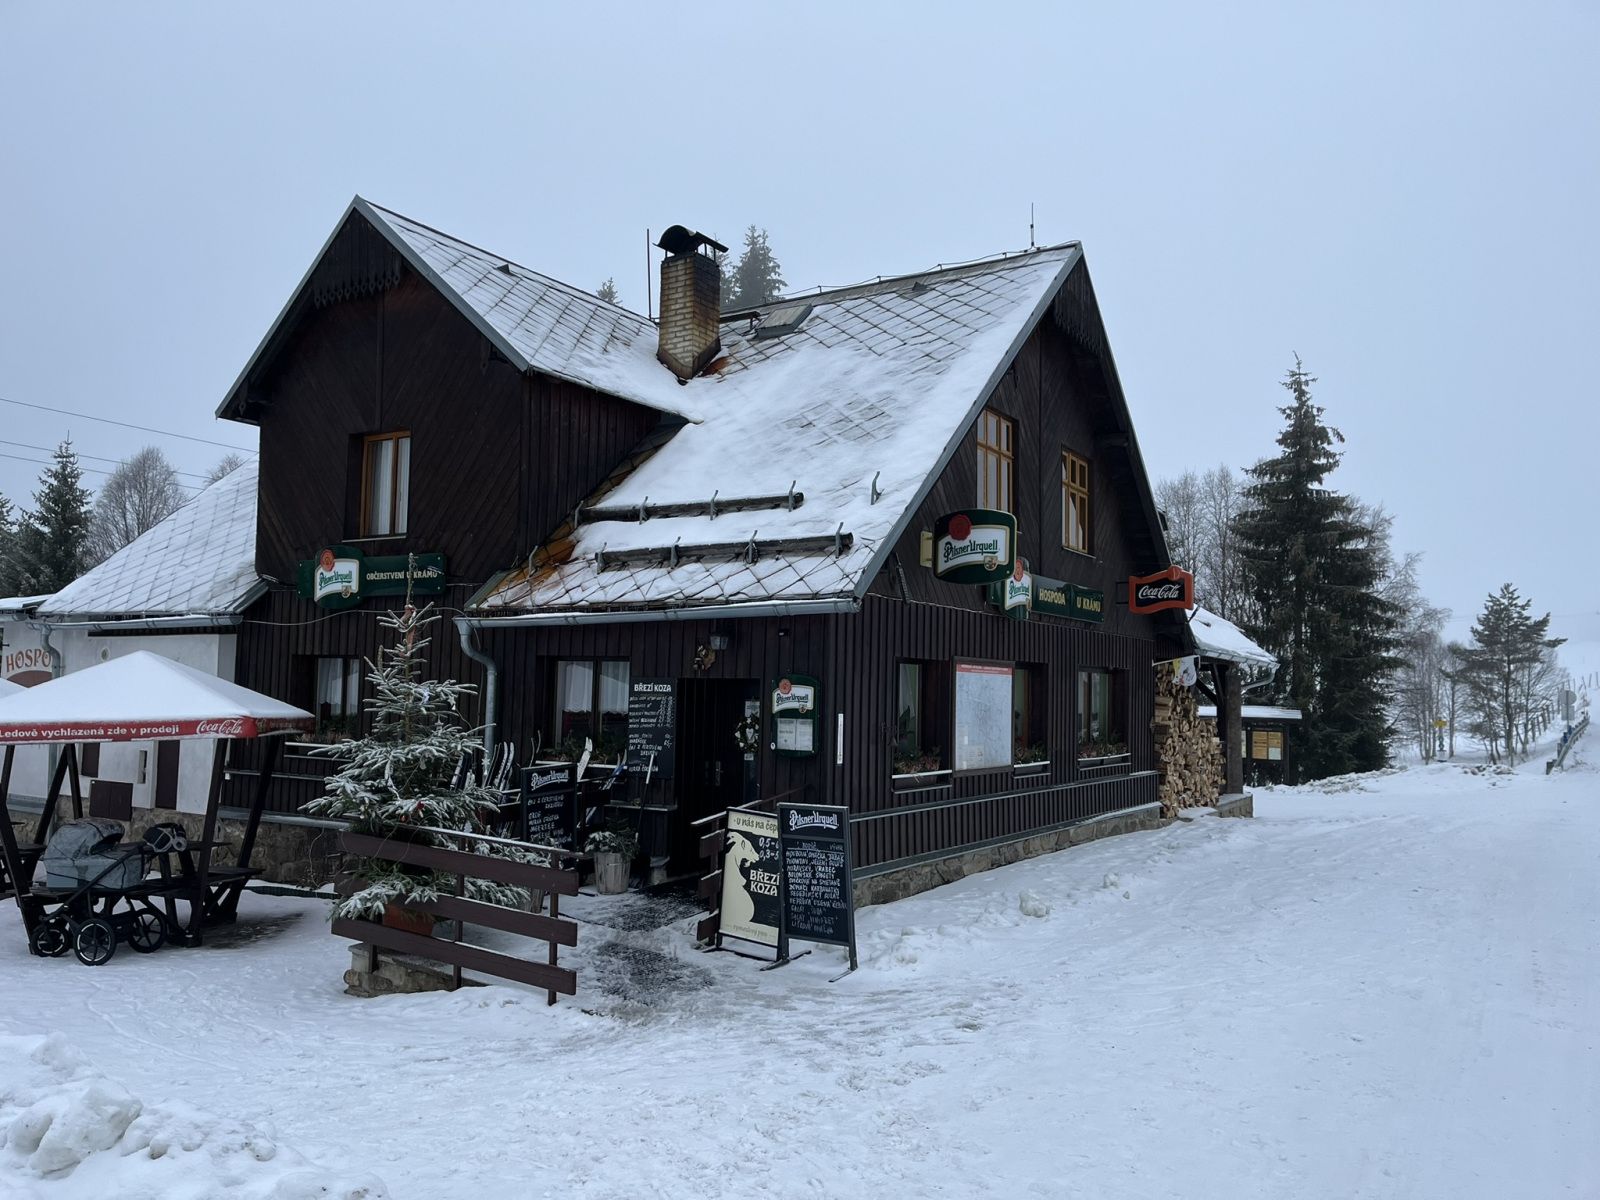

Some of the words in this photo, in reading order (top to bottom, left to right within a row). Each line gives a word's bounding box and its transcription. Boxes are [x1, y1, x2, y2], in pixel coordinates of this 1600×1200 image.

[943, 541, 970, 564] Pilsner
[969, 539, 998, 556] Urquell
[366, 570, 405, 581] OBČERSTVENÍ
[1039, 588, 1066, 605] HOSPODA
[1076, 596, 1082, 609] U
[1138, 584, 1181, 599] Coca-Cola
[6, 649, 52, 672] HOSPO
[634, 683, 653, 692] BŘEZÍ
[653, 684, 672, 692] KOZA
[0, 728, 38, 738] Ledově
[41, 726, 104, 740] vychlazená
[107, 727, 127, 735] zde
[140, 724, 180, 736] prodeji
[196, 719, 243, 735] Coca-Cola
[742, 818, 755, 828] nás
[755, 821, 765, 830] na
[765, 820, 778, 834] čep
[789, 809, 814, 831] Pilsner
[812, 810, 839, 829] Urquell
[750, 868, 780, 886] BŘEZÍ
[750, 881, 778, 896] KOZA
